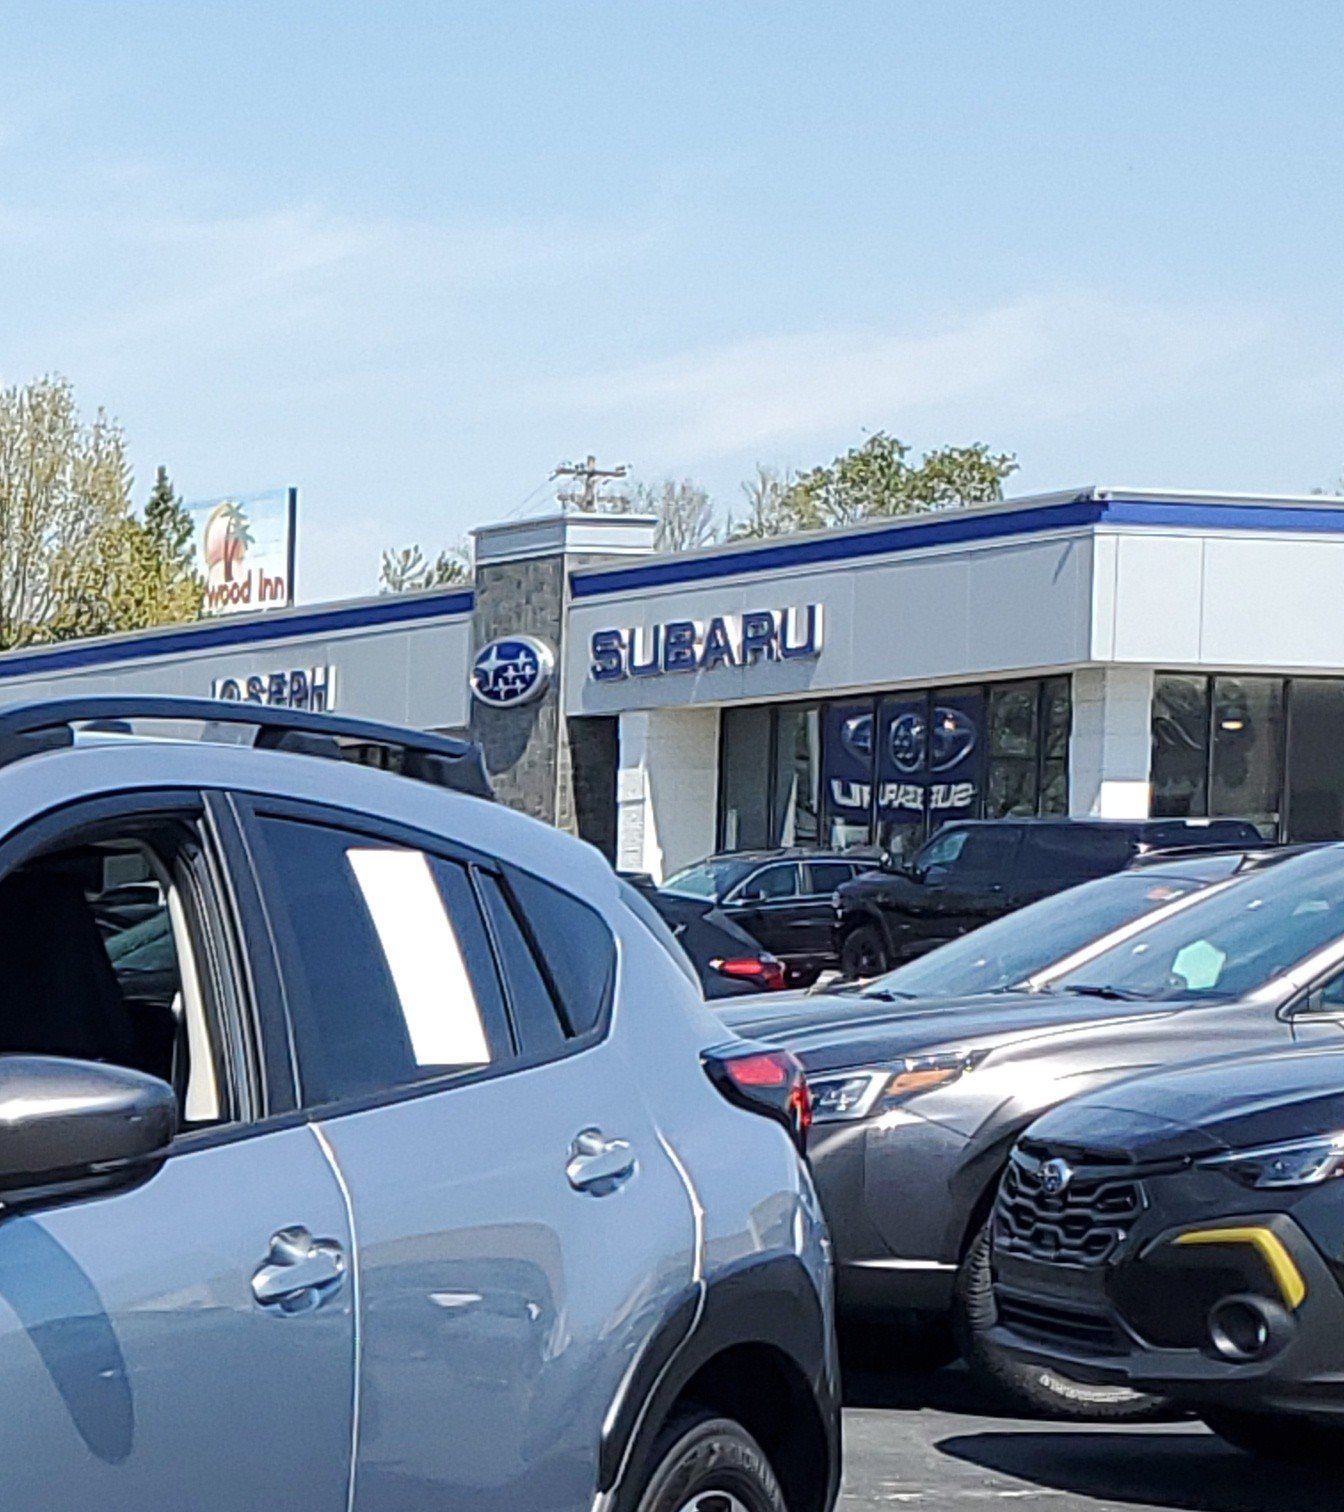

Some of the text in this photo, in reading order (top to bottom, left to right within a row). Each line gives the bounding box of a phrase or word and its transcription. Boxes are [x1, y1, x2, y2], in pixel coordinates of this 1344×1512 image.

[203, 567, 285, 608] wood Inn
[590, 603, 823, 682] SUBARU
